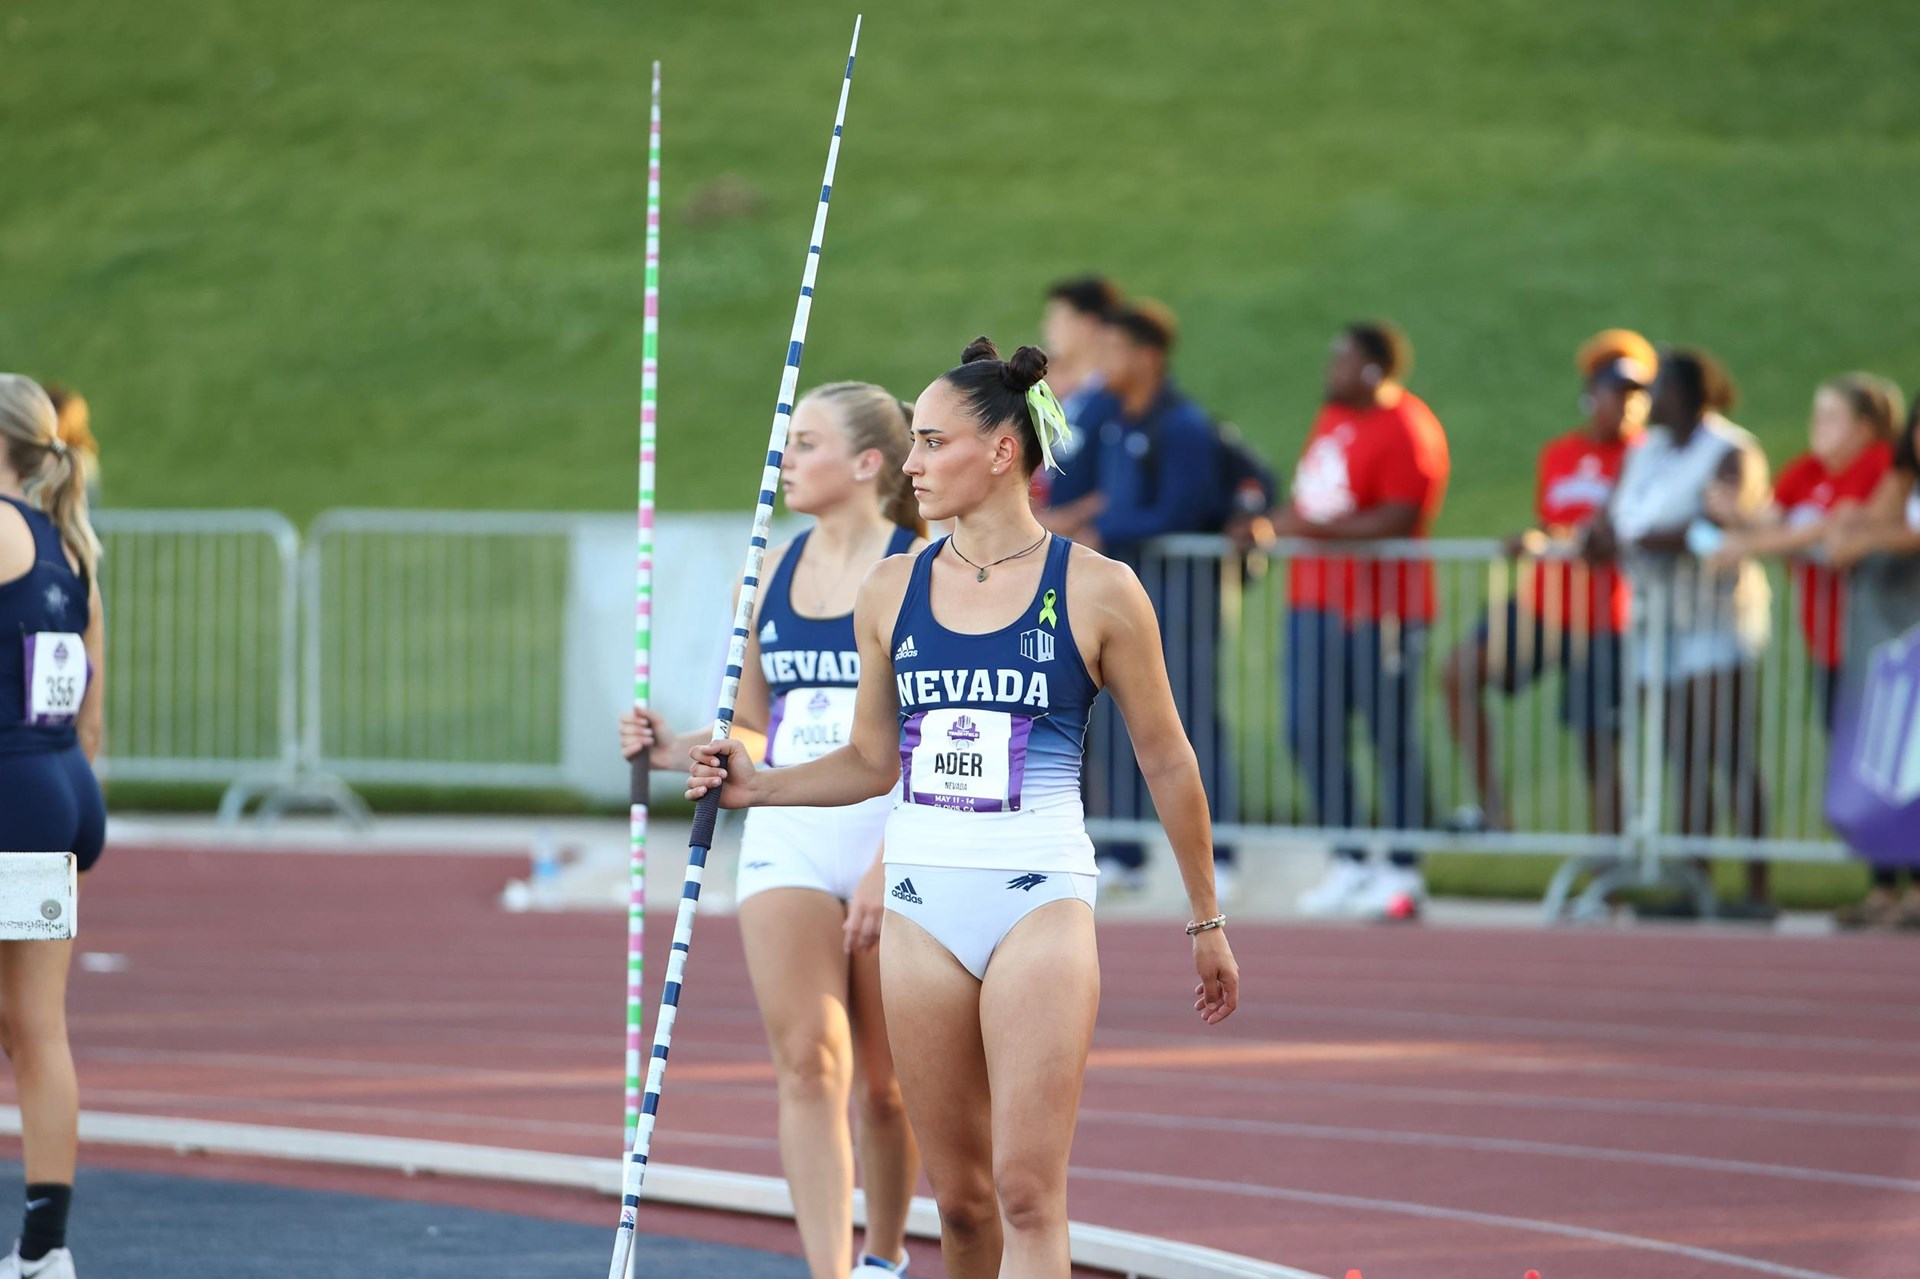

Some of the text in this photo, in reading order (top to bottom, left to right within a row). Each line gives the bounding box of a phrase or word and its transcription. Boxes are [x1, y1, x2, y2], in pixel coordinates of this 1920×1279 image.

[895, 649, 918, 661] adidas
[760, 650, 861, 684] NEVAD
[896, 668, 1050, 709] NEVADA
[792, 723, 841, 745] POOLE
[934, 751, 983, 777] ADER
[945, 781, 967, 791] NEVADA
[935, 795, 951, 803] MAY
[953, 796, 960, 804] 11
[966, 797, 975, 805] 14
[891, 889, 923, 905] adidas
